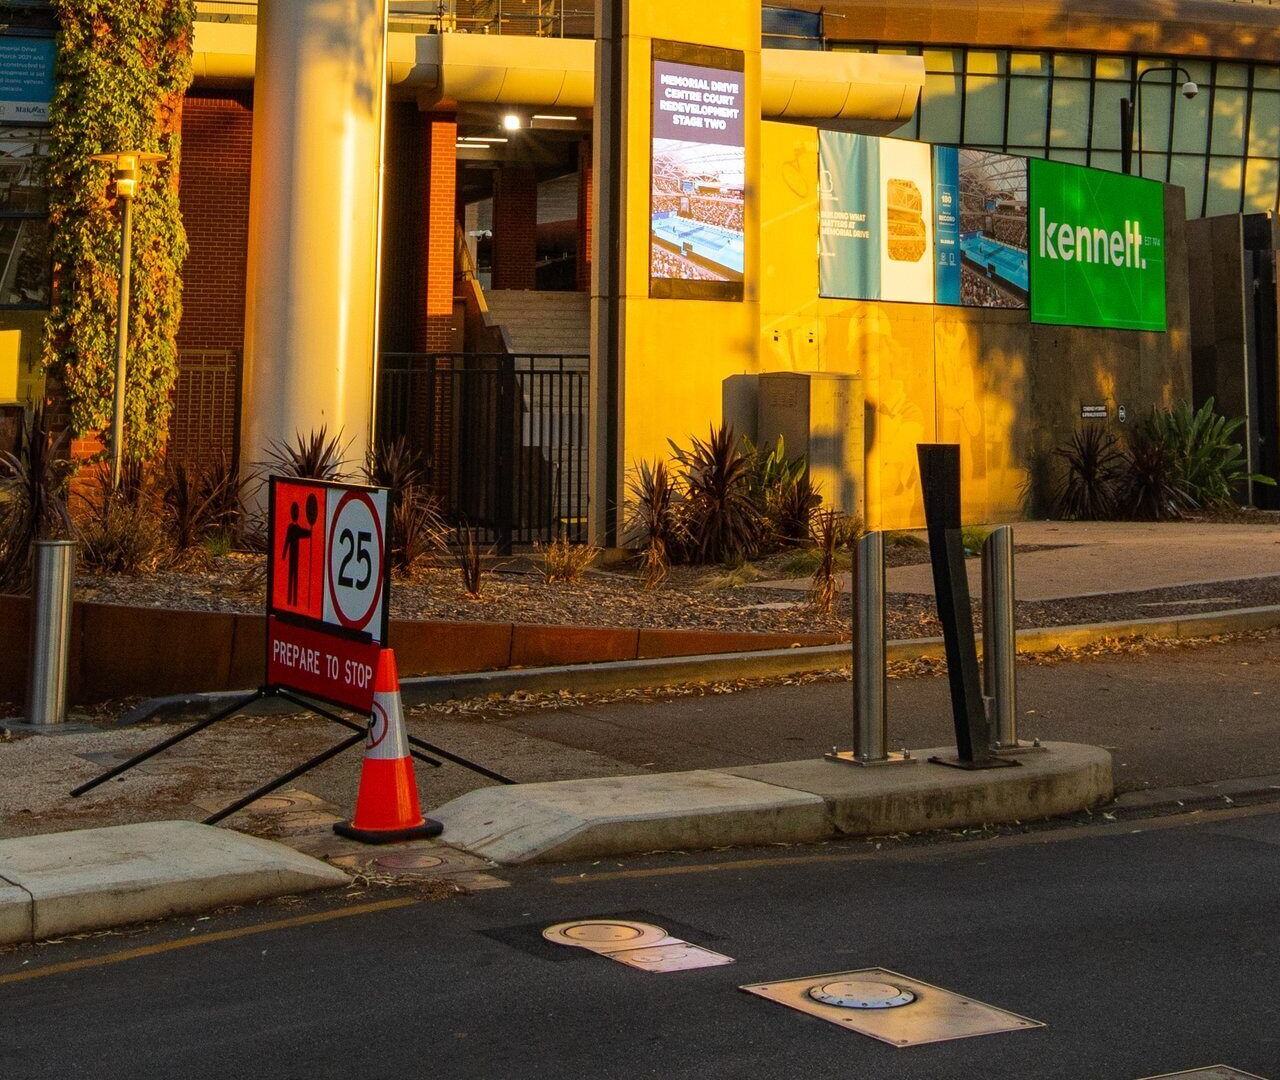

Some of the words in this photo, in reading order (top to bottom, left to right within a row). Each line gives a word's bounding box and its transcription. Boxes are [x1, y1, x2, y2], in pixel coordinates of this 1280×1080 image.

[660, 74, 710, 91] MEMORIAL
[711, 80, 739, 94] DRIVE
[664, 87, 702, 102] CENTRE
[703, 92, 735, 106] COURT
[659, 99, 740, 119] REDEVELOPMENT
[672, 114, 703, 128] STAGE
[703, 117, 727, 130] TWO
[848, 221, 856, 229] AT
[849, 213, 866, 222] WHAT
[821, 226, 853, 237] MEMORIAL
[852, 229, 870, 238] DRIVE
[1039, 207, 1147, 269] kennett.
[337, 527, 373, 591] 25
[273, 639, 320, 675] PREPARE
[326, 654, 339, 680] TO
[344, 659, 373, 689] STOP
